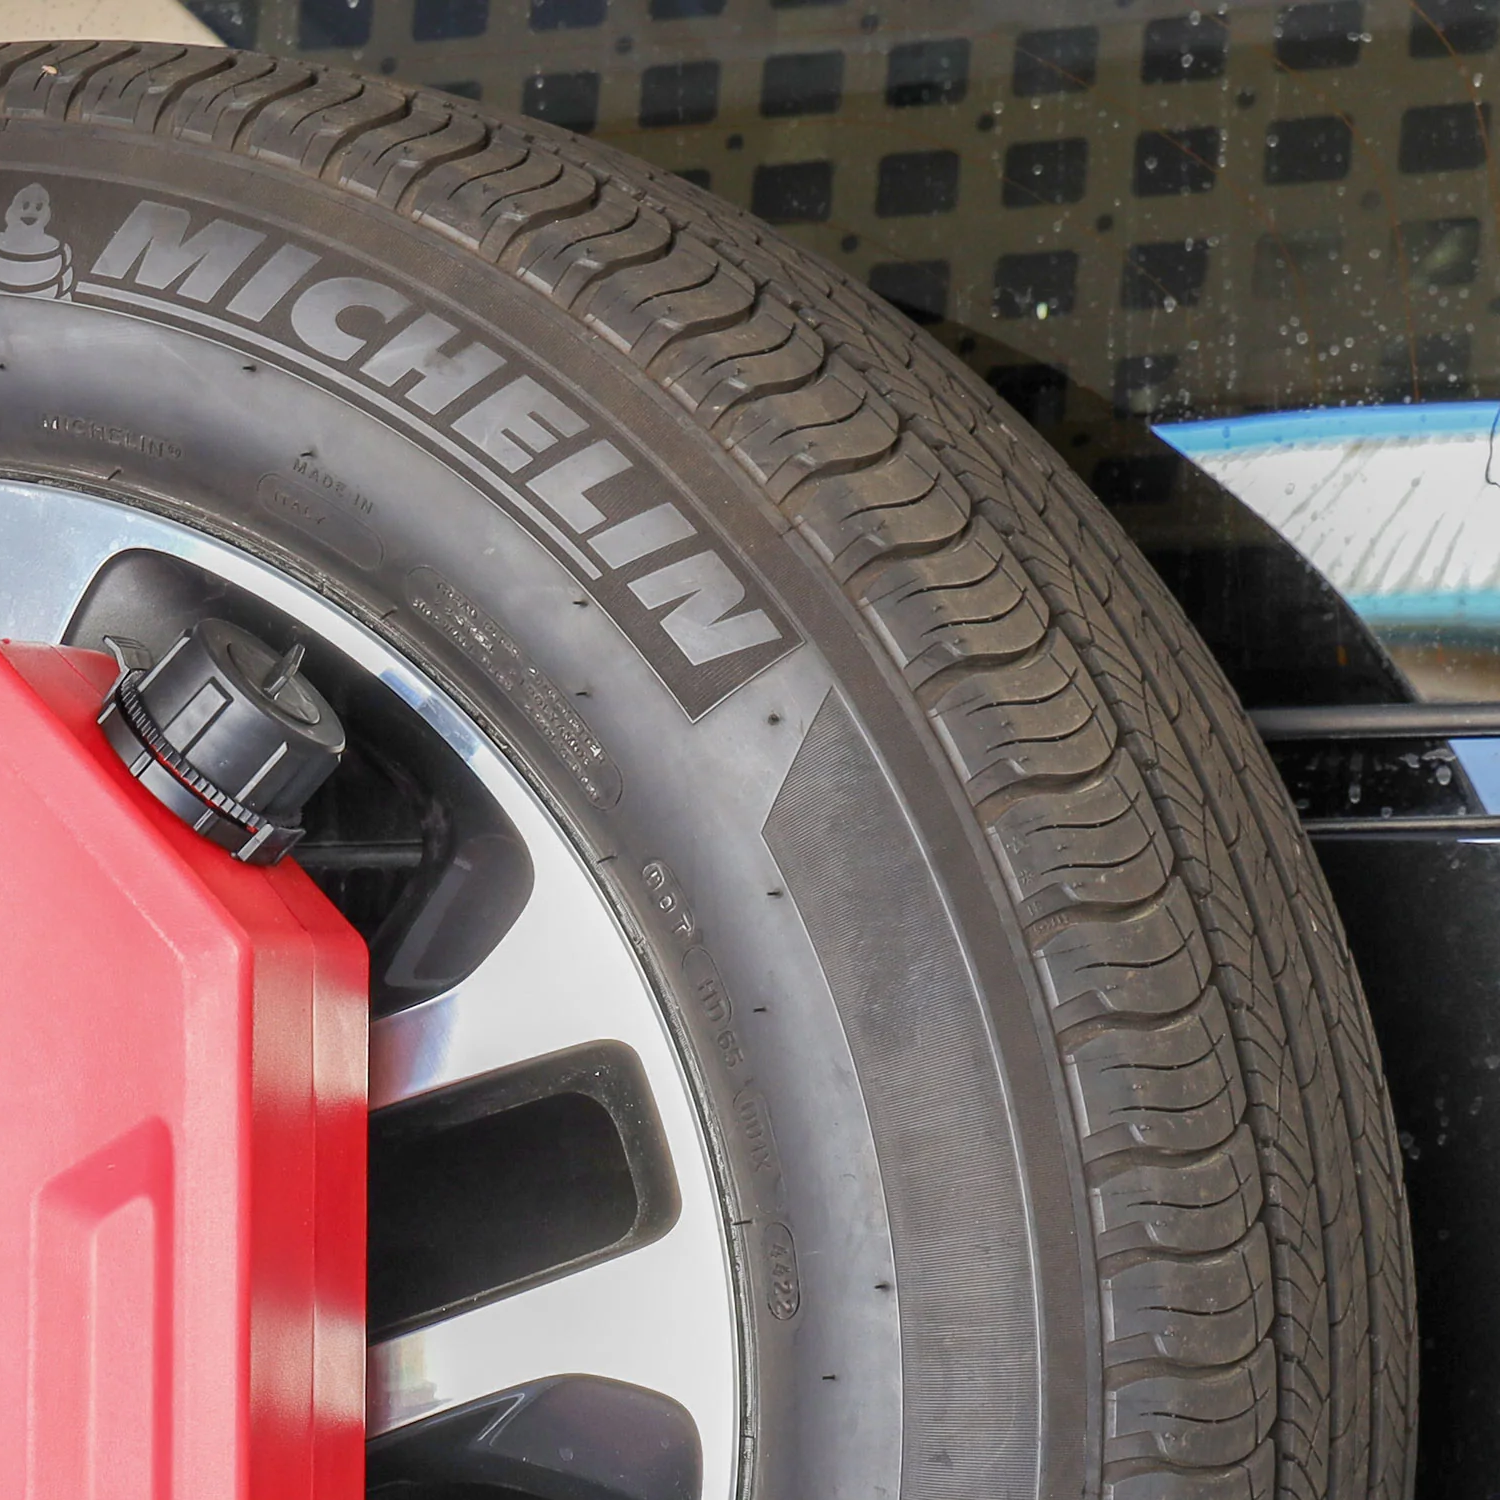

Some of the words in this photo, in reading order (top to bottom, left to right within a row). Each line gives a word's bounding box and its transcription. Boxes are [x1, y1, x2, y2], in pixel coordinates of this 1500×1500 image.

[90, 200, 781, 666] MICHELIN
[291, 456, 347, 498] MADE
[351, 491, 375, 516] IN
[767, 1240, 795, 1315] 4422
